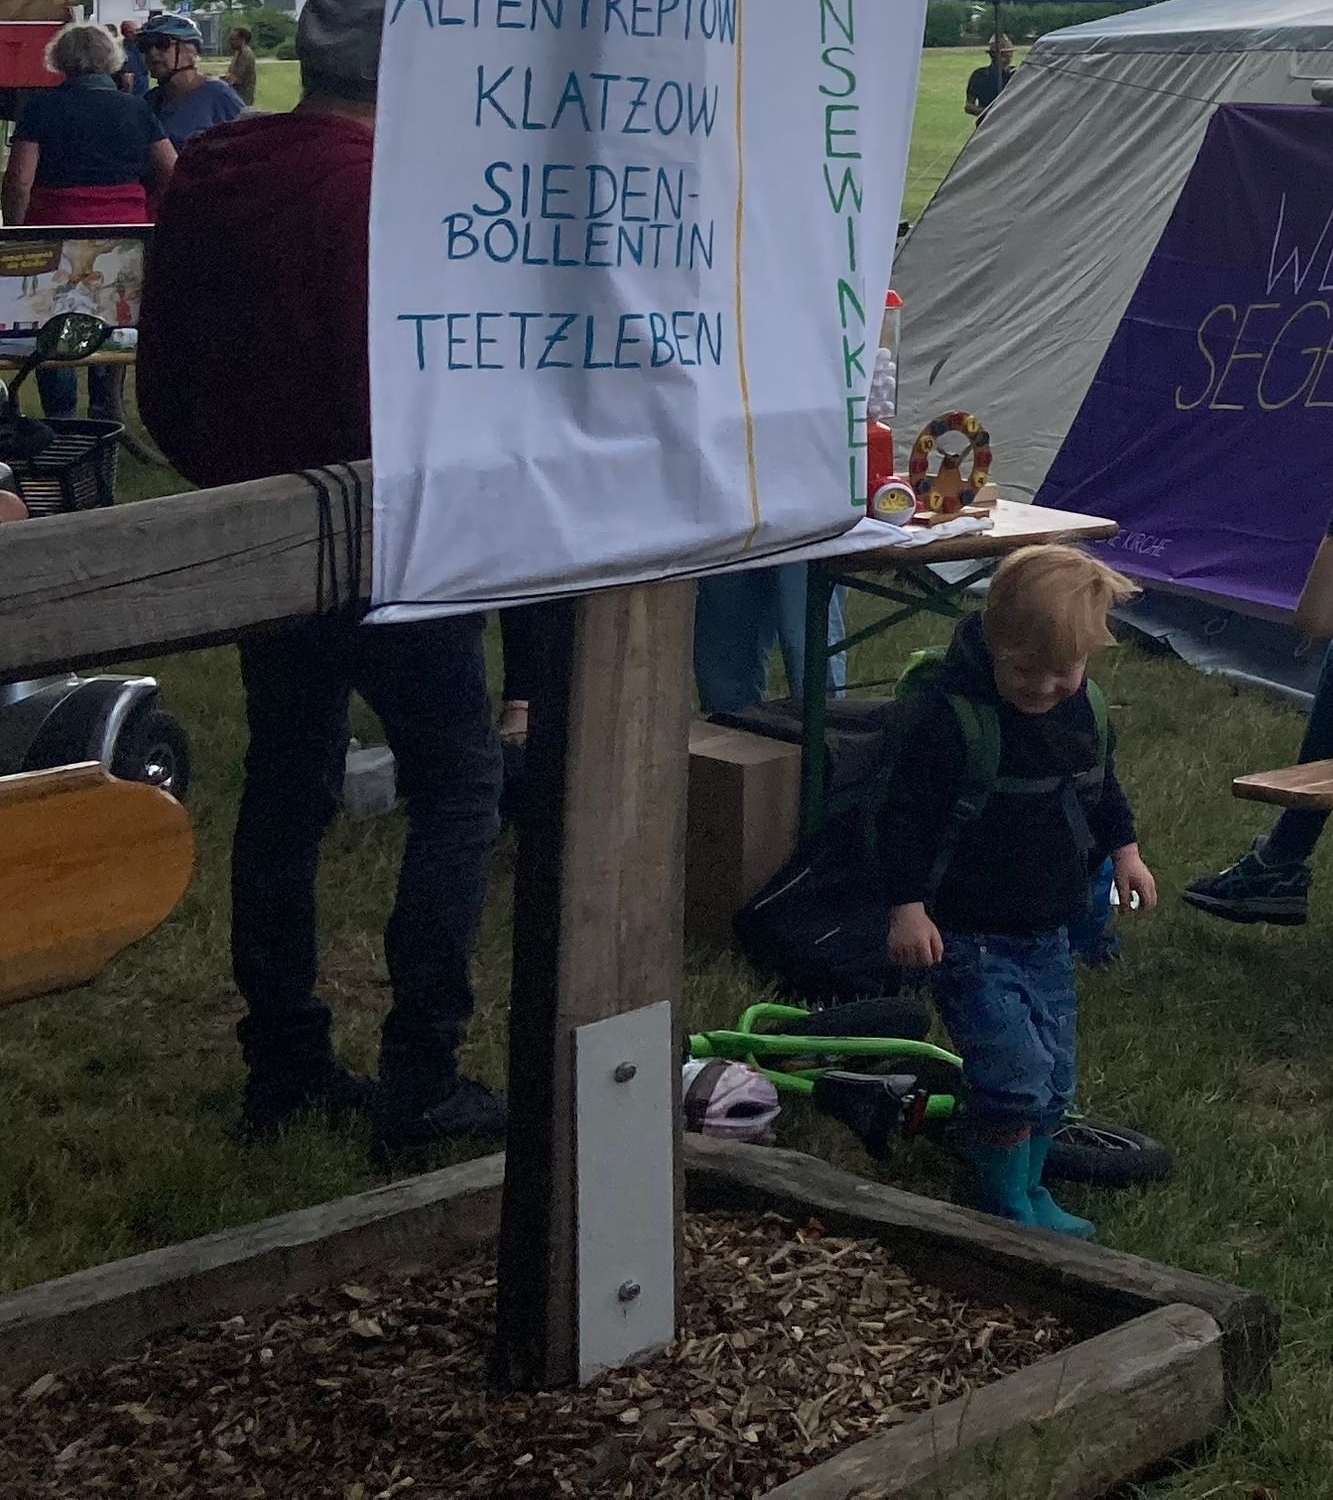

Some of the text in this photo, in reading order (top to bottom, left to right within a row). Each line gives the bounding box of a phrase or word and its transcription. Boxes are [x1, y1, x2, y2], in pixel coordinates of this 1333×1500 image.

[475, 65, 718, 137] KLATZOW
[473, 161, 699, 222] SIEDEN-
[398, 311, 722, 370] TEETZLEBEN
